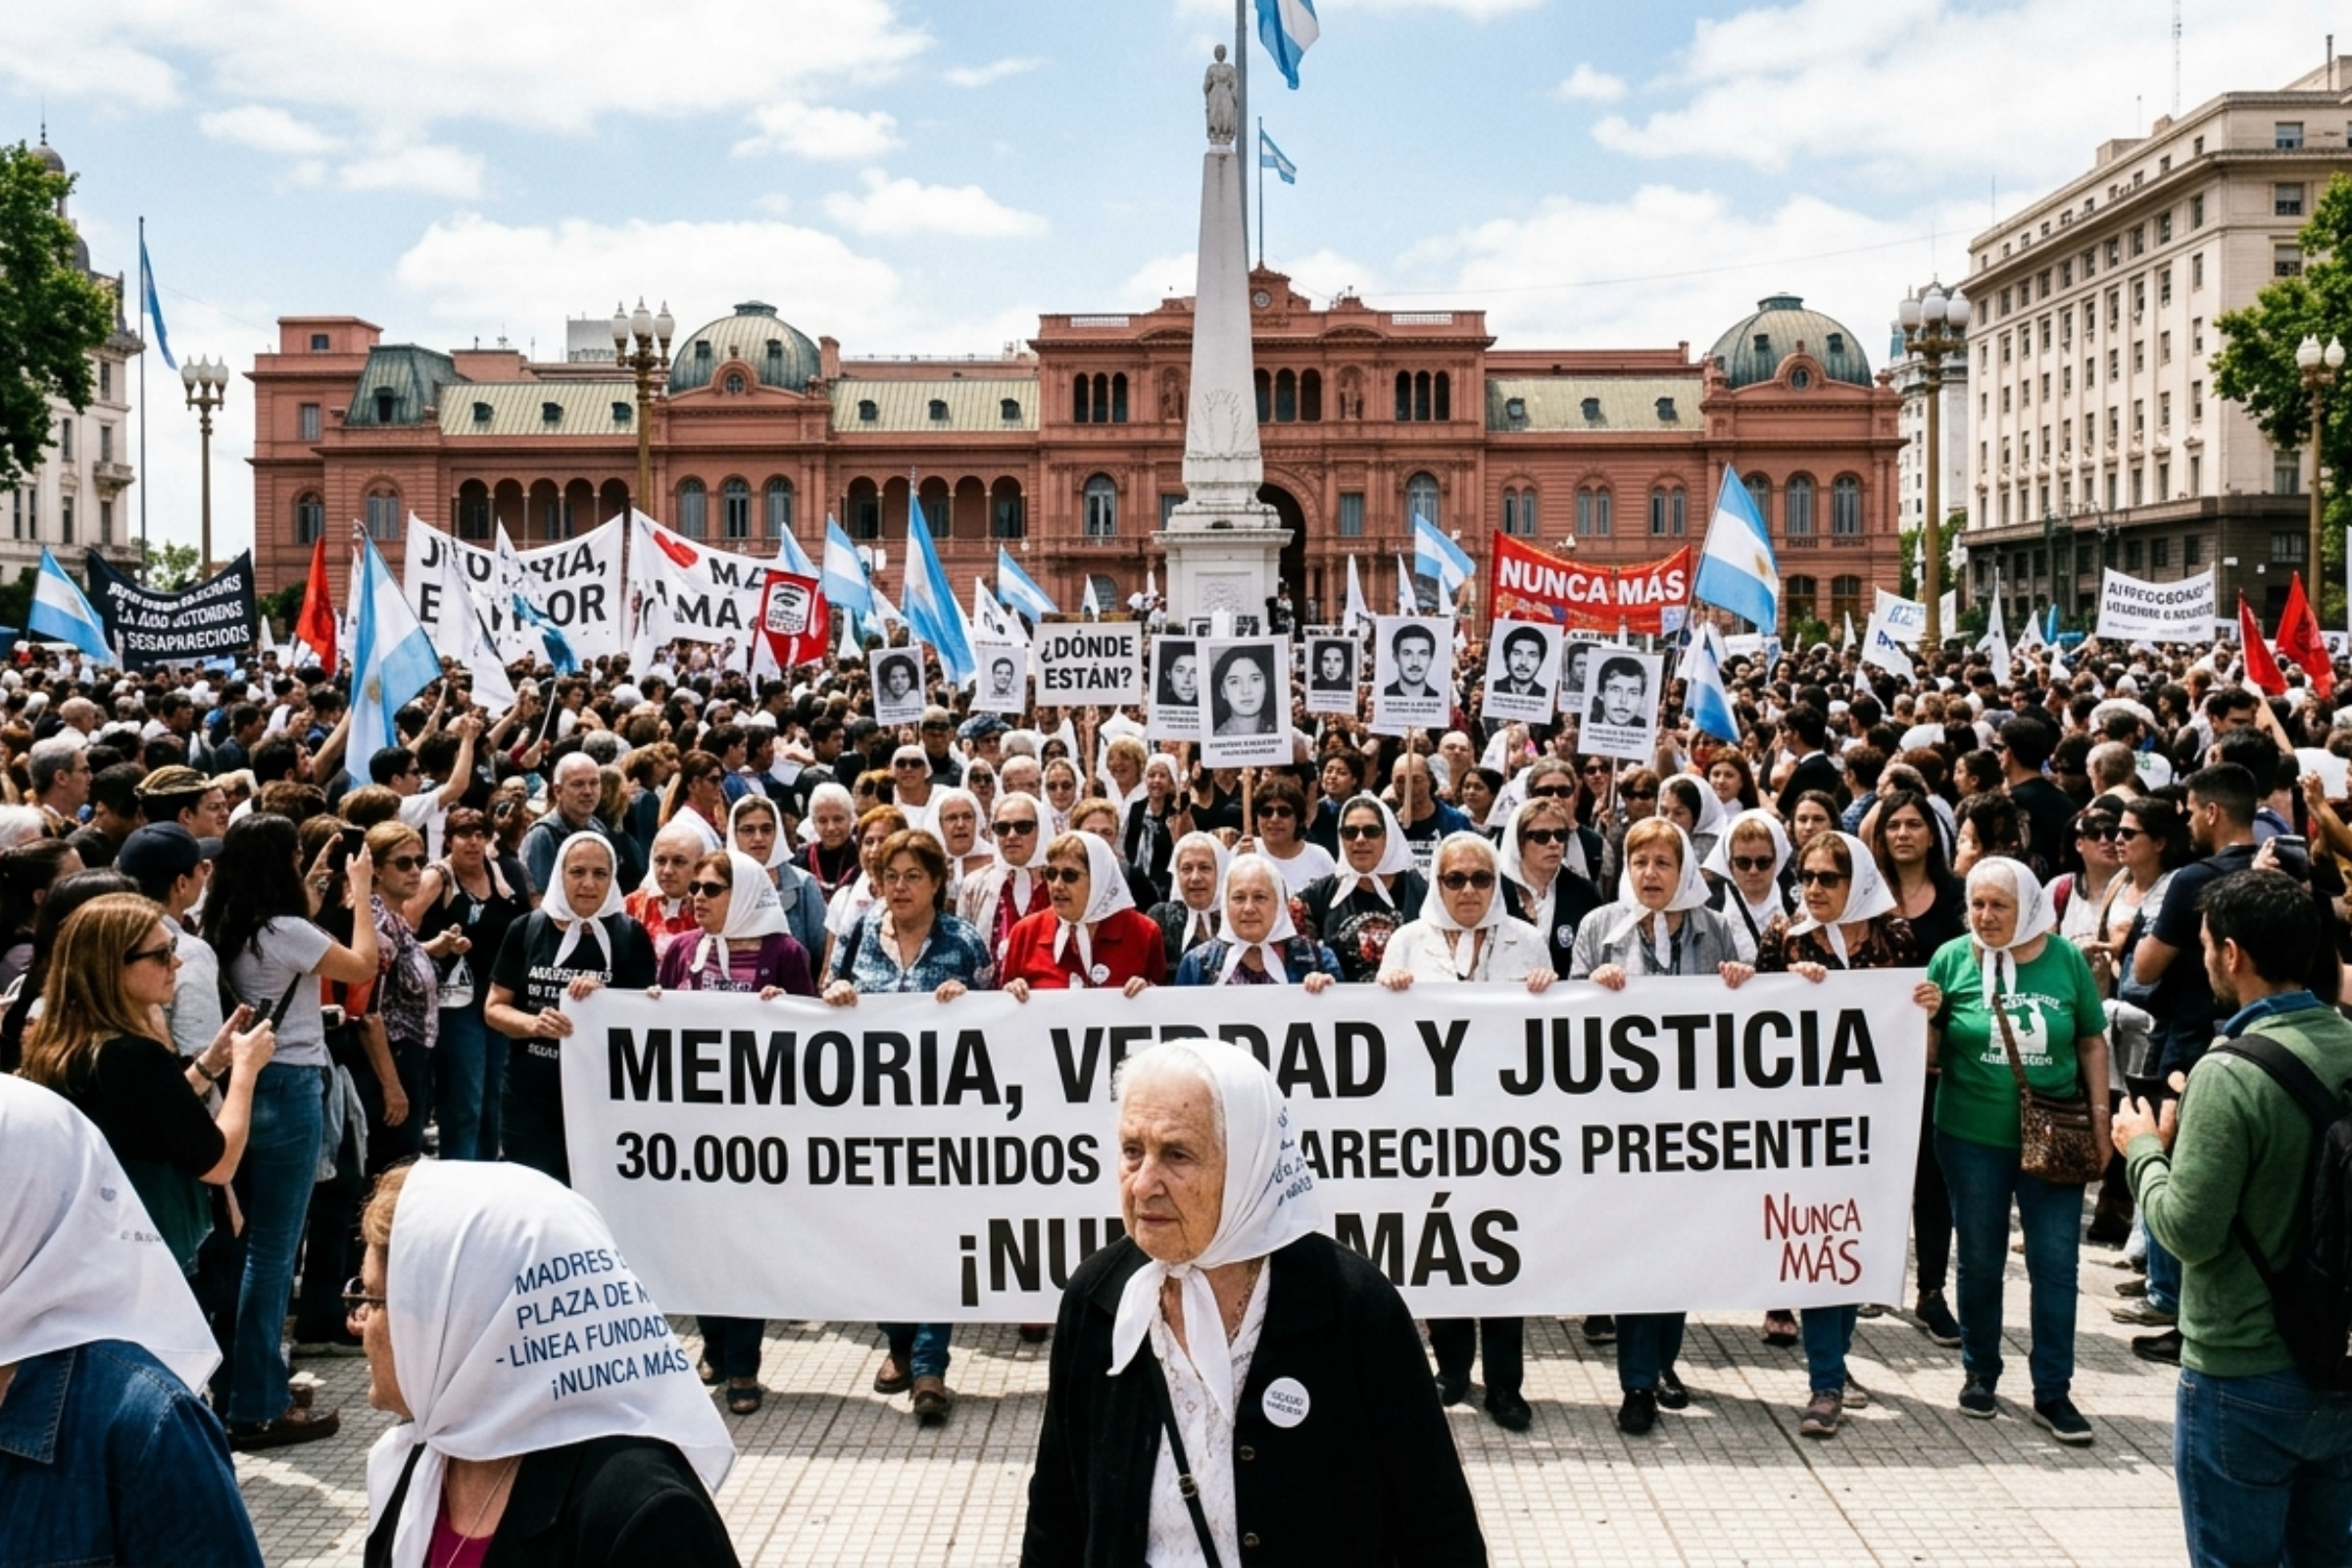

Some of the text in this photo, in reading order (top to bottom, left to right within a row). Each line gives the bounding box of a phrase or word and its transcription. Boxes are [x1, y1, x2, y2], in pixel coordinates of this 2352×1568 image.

[1498, 556, 1686, 605] NUNCA MÁS
[1041, 629, 1133, 663] ¿DÓNDE
[1045, 662, 1133, 689] ESTÁN?
[607, 1027, 1023, 1122] MEMORIA,
[1415, 1019, 1471, 1097] Y
[1498, 1007, 1884, 1097] JUSTICIA
[615, 1131, 789, 1185] 30.000
[808, 1134, 1101, 1187] DETENIDOS
[1582, 1115, 1871, 1175] PRESENTE!
[1334, 1192, 1521, 1288] MÁS
[1764, 1192, 1862, 1241] NUNCA
[514, 1249, 614, 1296] MADRES
[1780, 1235, 1862, 1286] MÁS
[515, 1287, 600, 1331] PLAZA
[604, 1281, 634, 1308] DE
[509, 1330, 581, 1369] LÍNEA
[551, 1343, 690, 1402] ¡NUNCA MÁS
